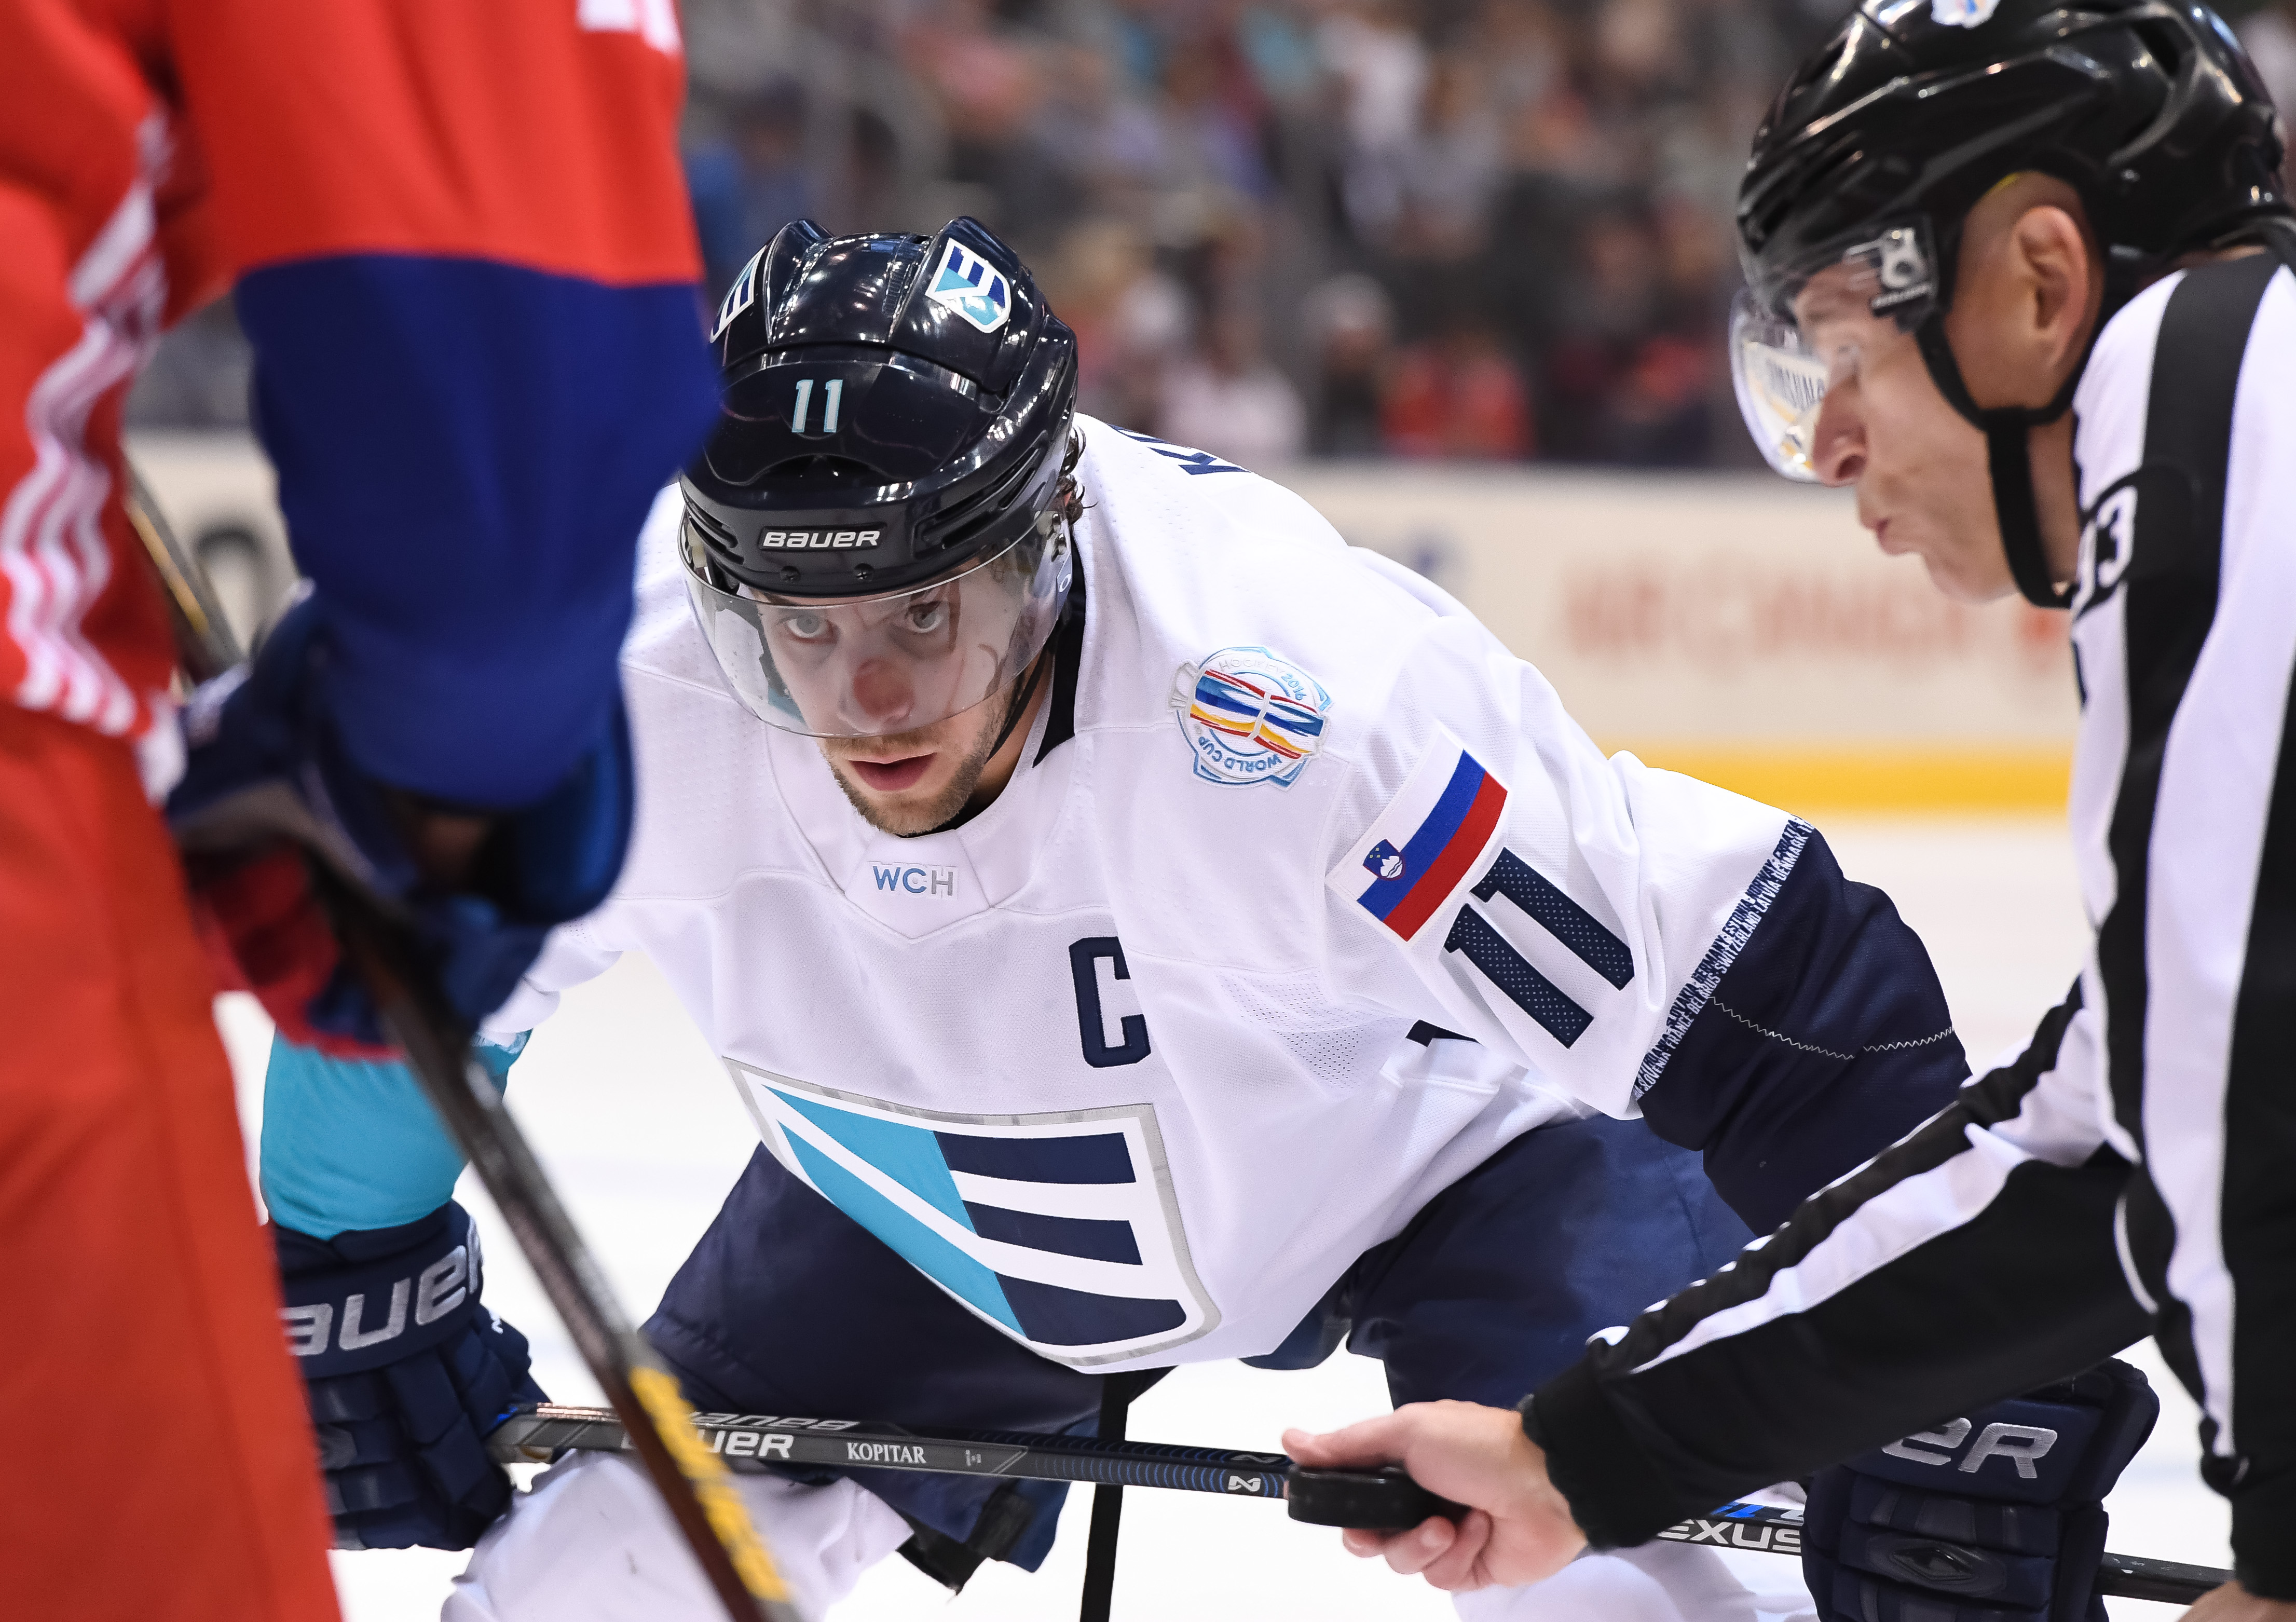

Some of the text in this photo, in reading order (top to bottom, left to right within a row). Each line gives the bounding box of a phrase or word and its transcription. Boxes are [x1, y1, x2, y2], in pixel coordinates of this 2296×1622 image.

[791, 378, 843, 433] 11
[762, 530, 881, 548] BAUER
[1219, 659, 1307, 701] HOCKEY 2016
[1198, 736, 1282, 773] WORLD CUP
[871, 865, 954, 897] WCH
[1443, 847, 1635, 1049] 11
[1663, 1011, 1694, 1050] FRANCE
[1686, 971, 1721, 1015] BELARUS
[1713, 909, 1762, 975] SWITZERLAND
[1753, 879, 1782, 914] LATVIA
[1773, 832, 1808, 881] DENMARK
[1664, 981, 1699, 1029] SLOVAKIA
[1690, 934, 1729, 984] GERMANY
[1721, 897, 1753, 938] ESTONIA
[1744, 858, 1779, 901] NORWAY
[1068, 936, 1152, 1068] C
[688, 1412, 861, 1432] BAUE
[846, 1441, 927, 1465] KOPITAR
